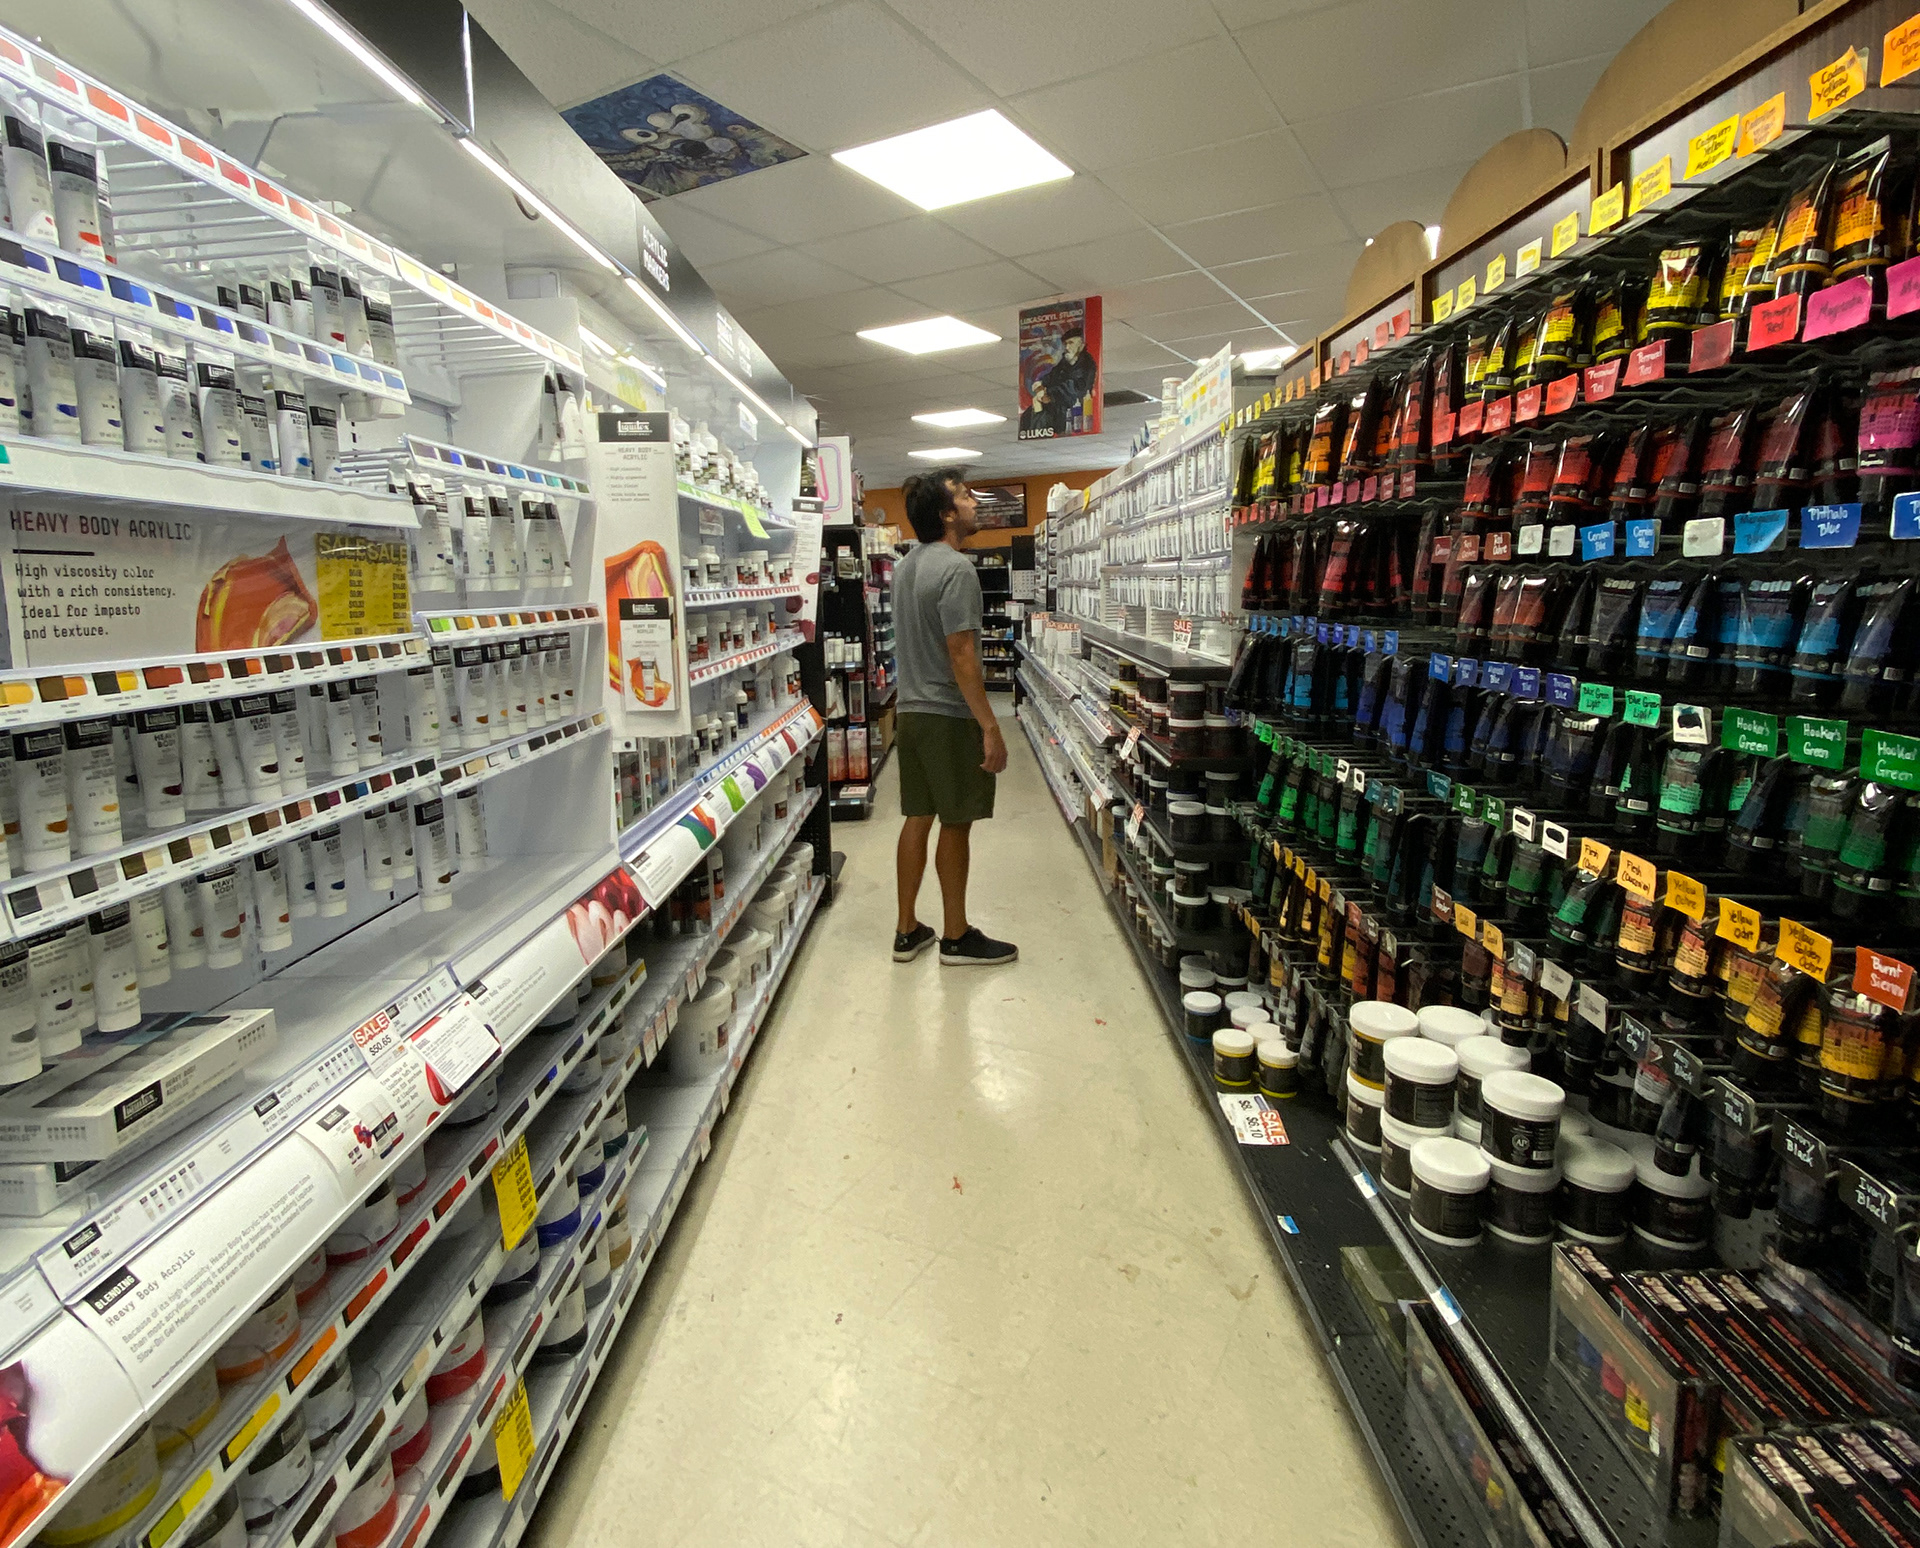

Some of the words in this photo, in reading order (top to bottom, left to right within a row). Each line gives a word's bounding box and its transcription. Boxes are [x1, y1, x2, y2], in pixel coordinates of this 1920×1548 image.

[1027, 427, 1054, 439] LUKAS
[10, 510, 69, 534] HEAVY
[79, 515, 119, 537] BODY
[129, 519, 192, 541] ACRYLIC
[1818, 522, 1841, 538] Blue
[367, 543, 407, 562] SALE
[15, 563, 48, 580] High
[54, 565, 117, 580] viscosity
[18, 585, 50, 598] with
[57, 587, 64, 598] a
[70, 585, 98, 598] rich
[104, 584, 176, 599] consistency.
[21, 604, 60, 619] Ideal
[67, 604, 88, 618] for
[94, 604, 141, 619] impasto
[23, 625, 47, 640] and
[54, 624, 109, 638] texture.
[1173, 620, 1192, 632] SALE
[1738, 735, 1769, 752] Green
[1803, 742, 1830, 759] Green
[1875, 759, 1913, 780] Green
[1870, 955, 1903, 979] Burnt
[355, 1014, 390, 1046] SALE
[368, 1034, 393, 1057] $50.65
[1262, 1111, 1287, 1145] SALE
[1786, 1123, 1815, 1155] Ivory
[1785, 1138, 1814, 1168] Black
[1858, 1176, 1887, 1207] Ivory
[1854, 1189, 1888, 1224] Black
[94, 1274, 136, 1311] BLENDING
[104, 1300, 136, 1327] Heavy
[135, 1279, 160, 1301] Body
[160, 1248, 196, 1280] Acrylic
